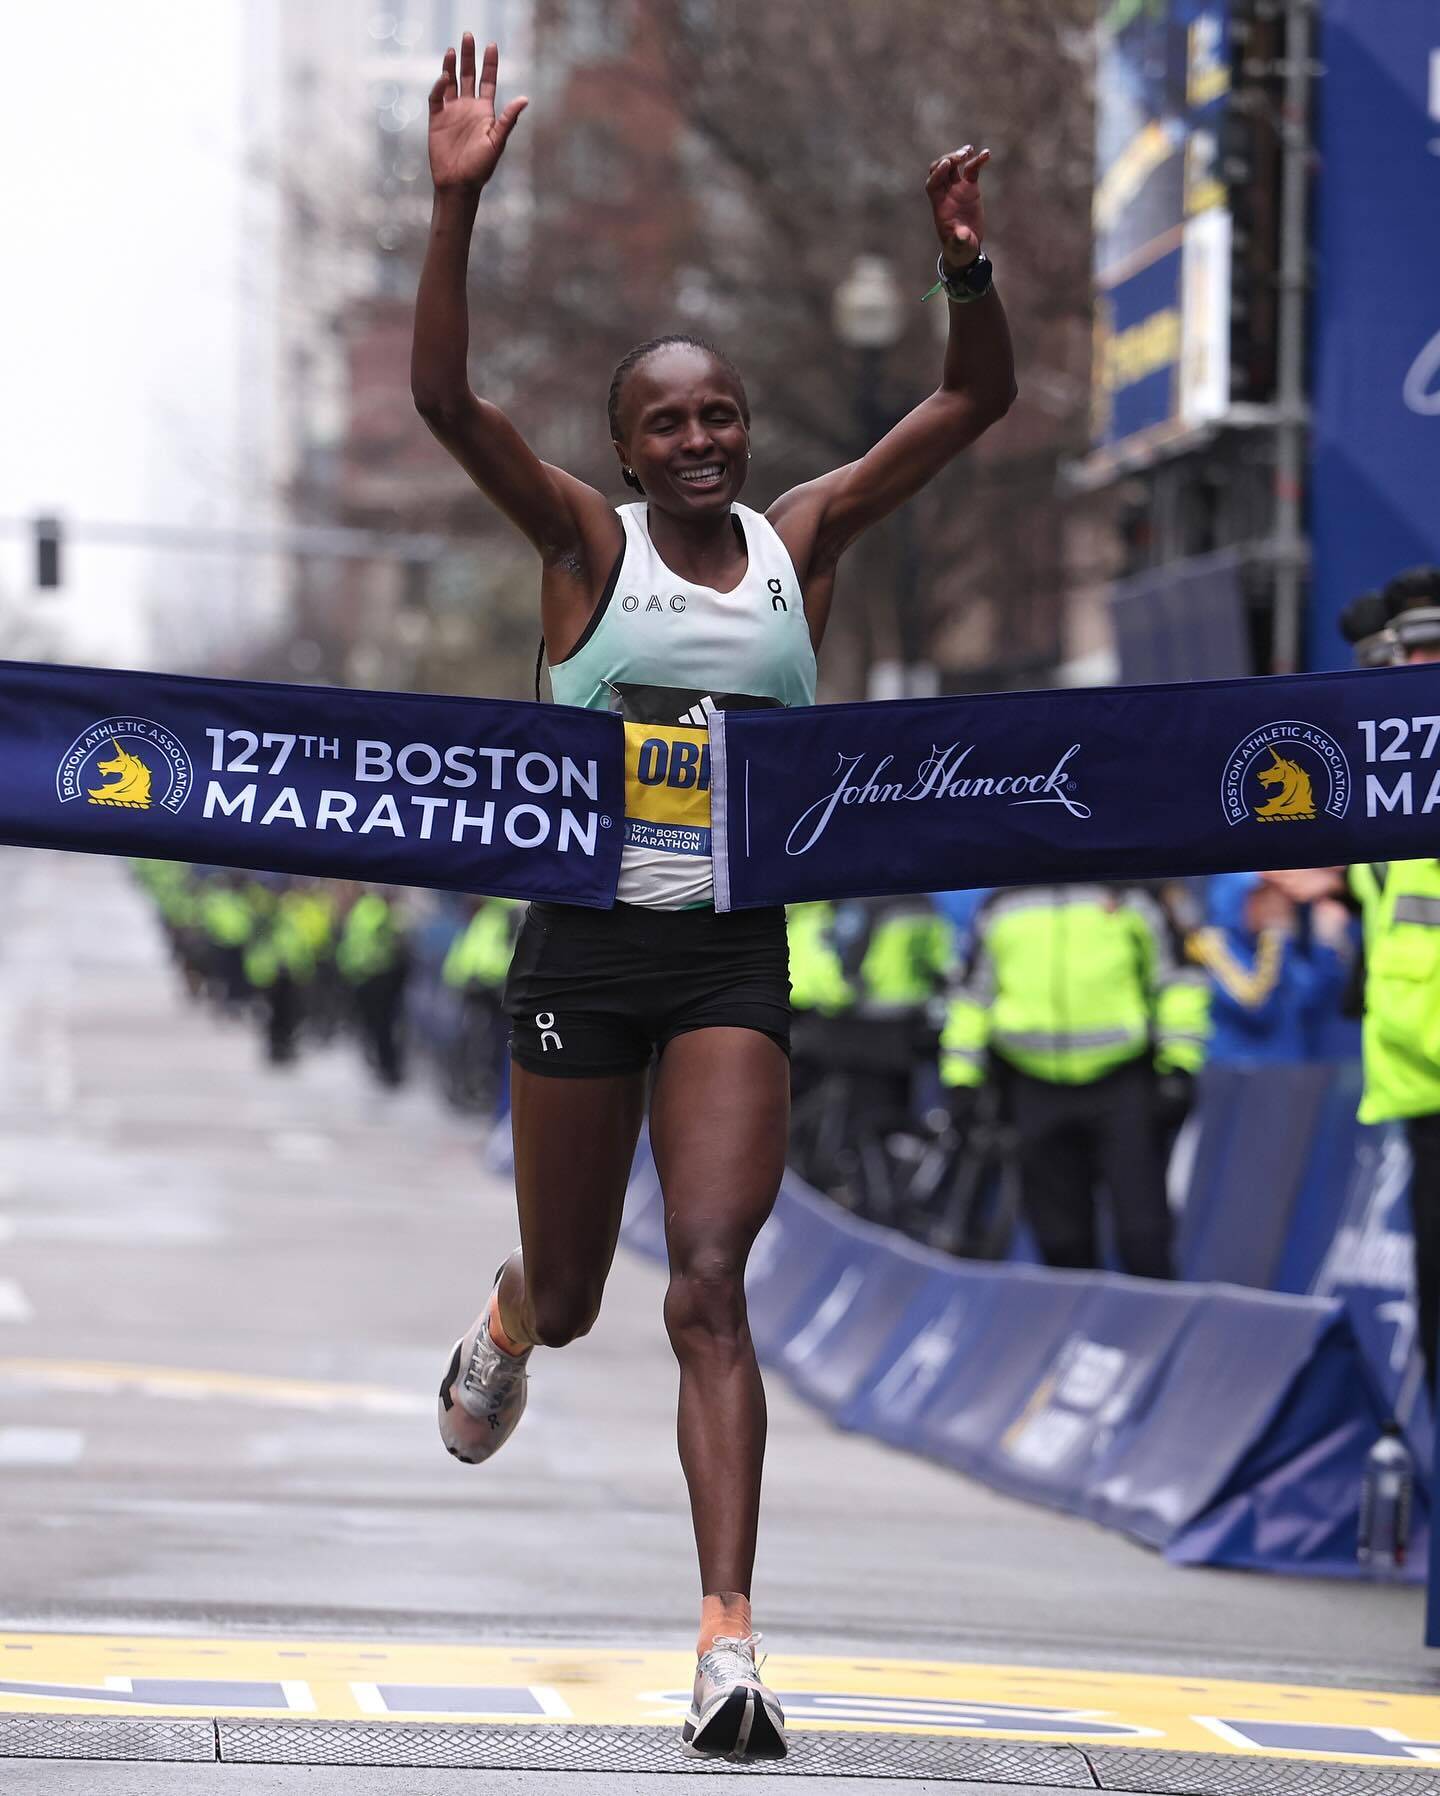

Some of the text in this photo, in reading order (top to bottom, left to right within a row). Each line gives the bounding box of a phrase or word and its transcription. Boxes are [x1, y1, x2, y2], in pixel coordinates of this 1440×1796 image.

[63, 721, 188, 807] BOSTON ATHLETIC ASSOCIATION
[205, 728, 599, 801] 127TH BOSTON
[785, 752, 903, 855] John
[1227, 726, 1346, 817] BOSTON ATHLETIC ASSOCIATION
[656, 828, 700, 841] BOSTON
